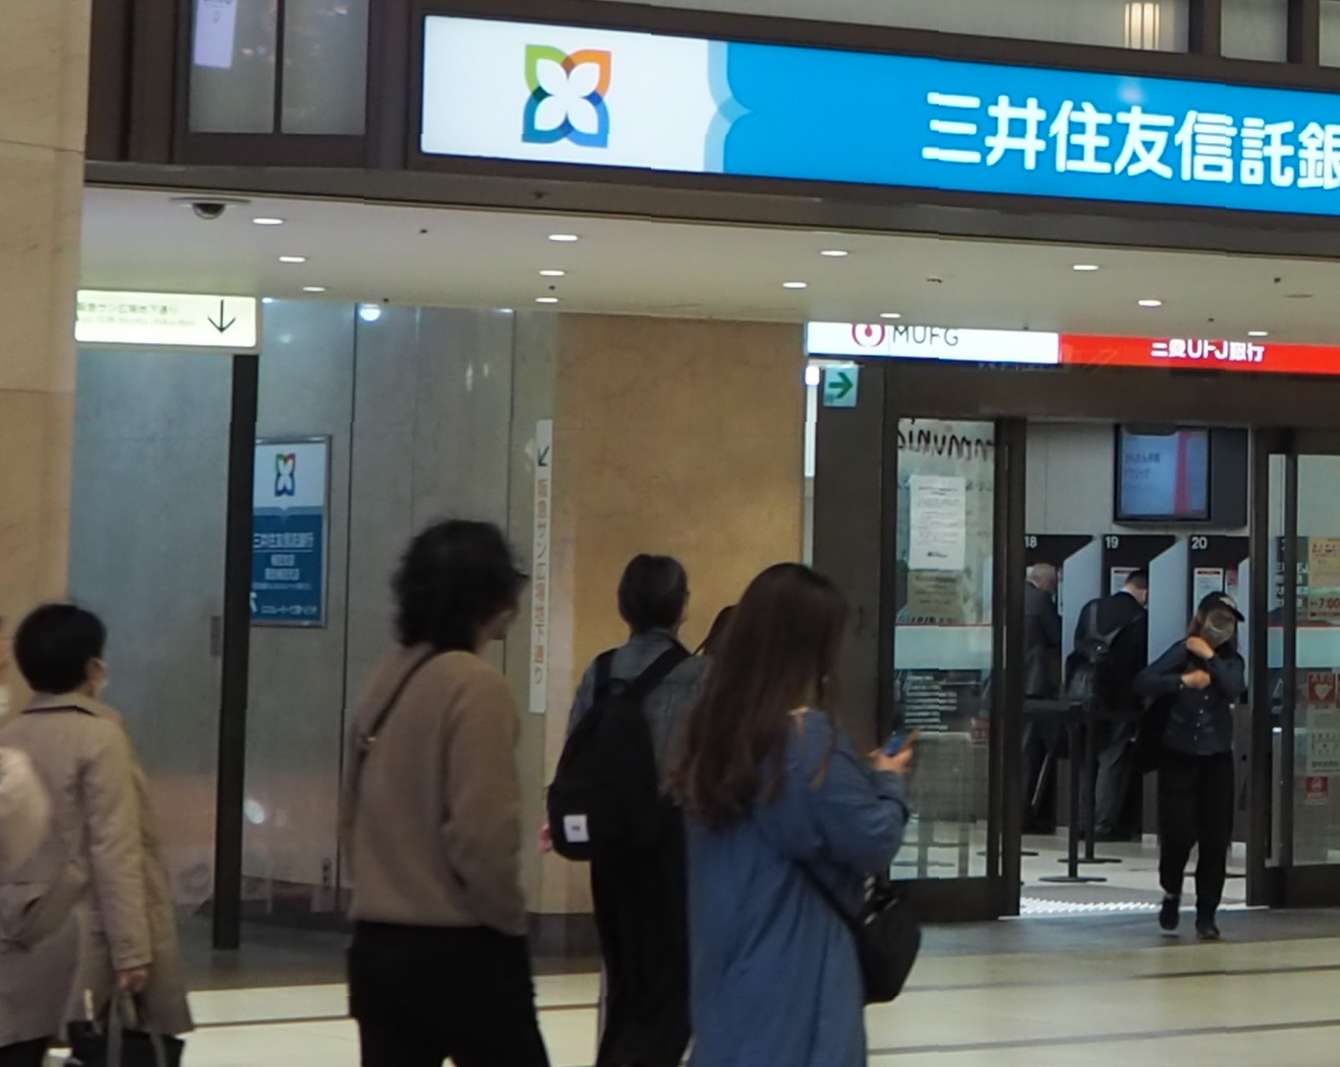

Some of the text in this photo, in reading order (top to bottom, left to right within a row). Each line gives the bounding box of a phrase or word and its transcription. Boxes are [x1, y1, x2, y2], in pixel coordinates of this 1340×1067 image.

[892, 325, 959, 347] MUFG
[1024, 536, 1037, 548] 18
[1105, 536, 1119, 549] 19
[1191, 536, 1207, 549] 20
